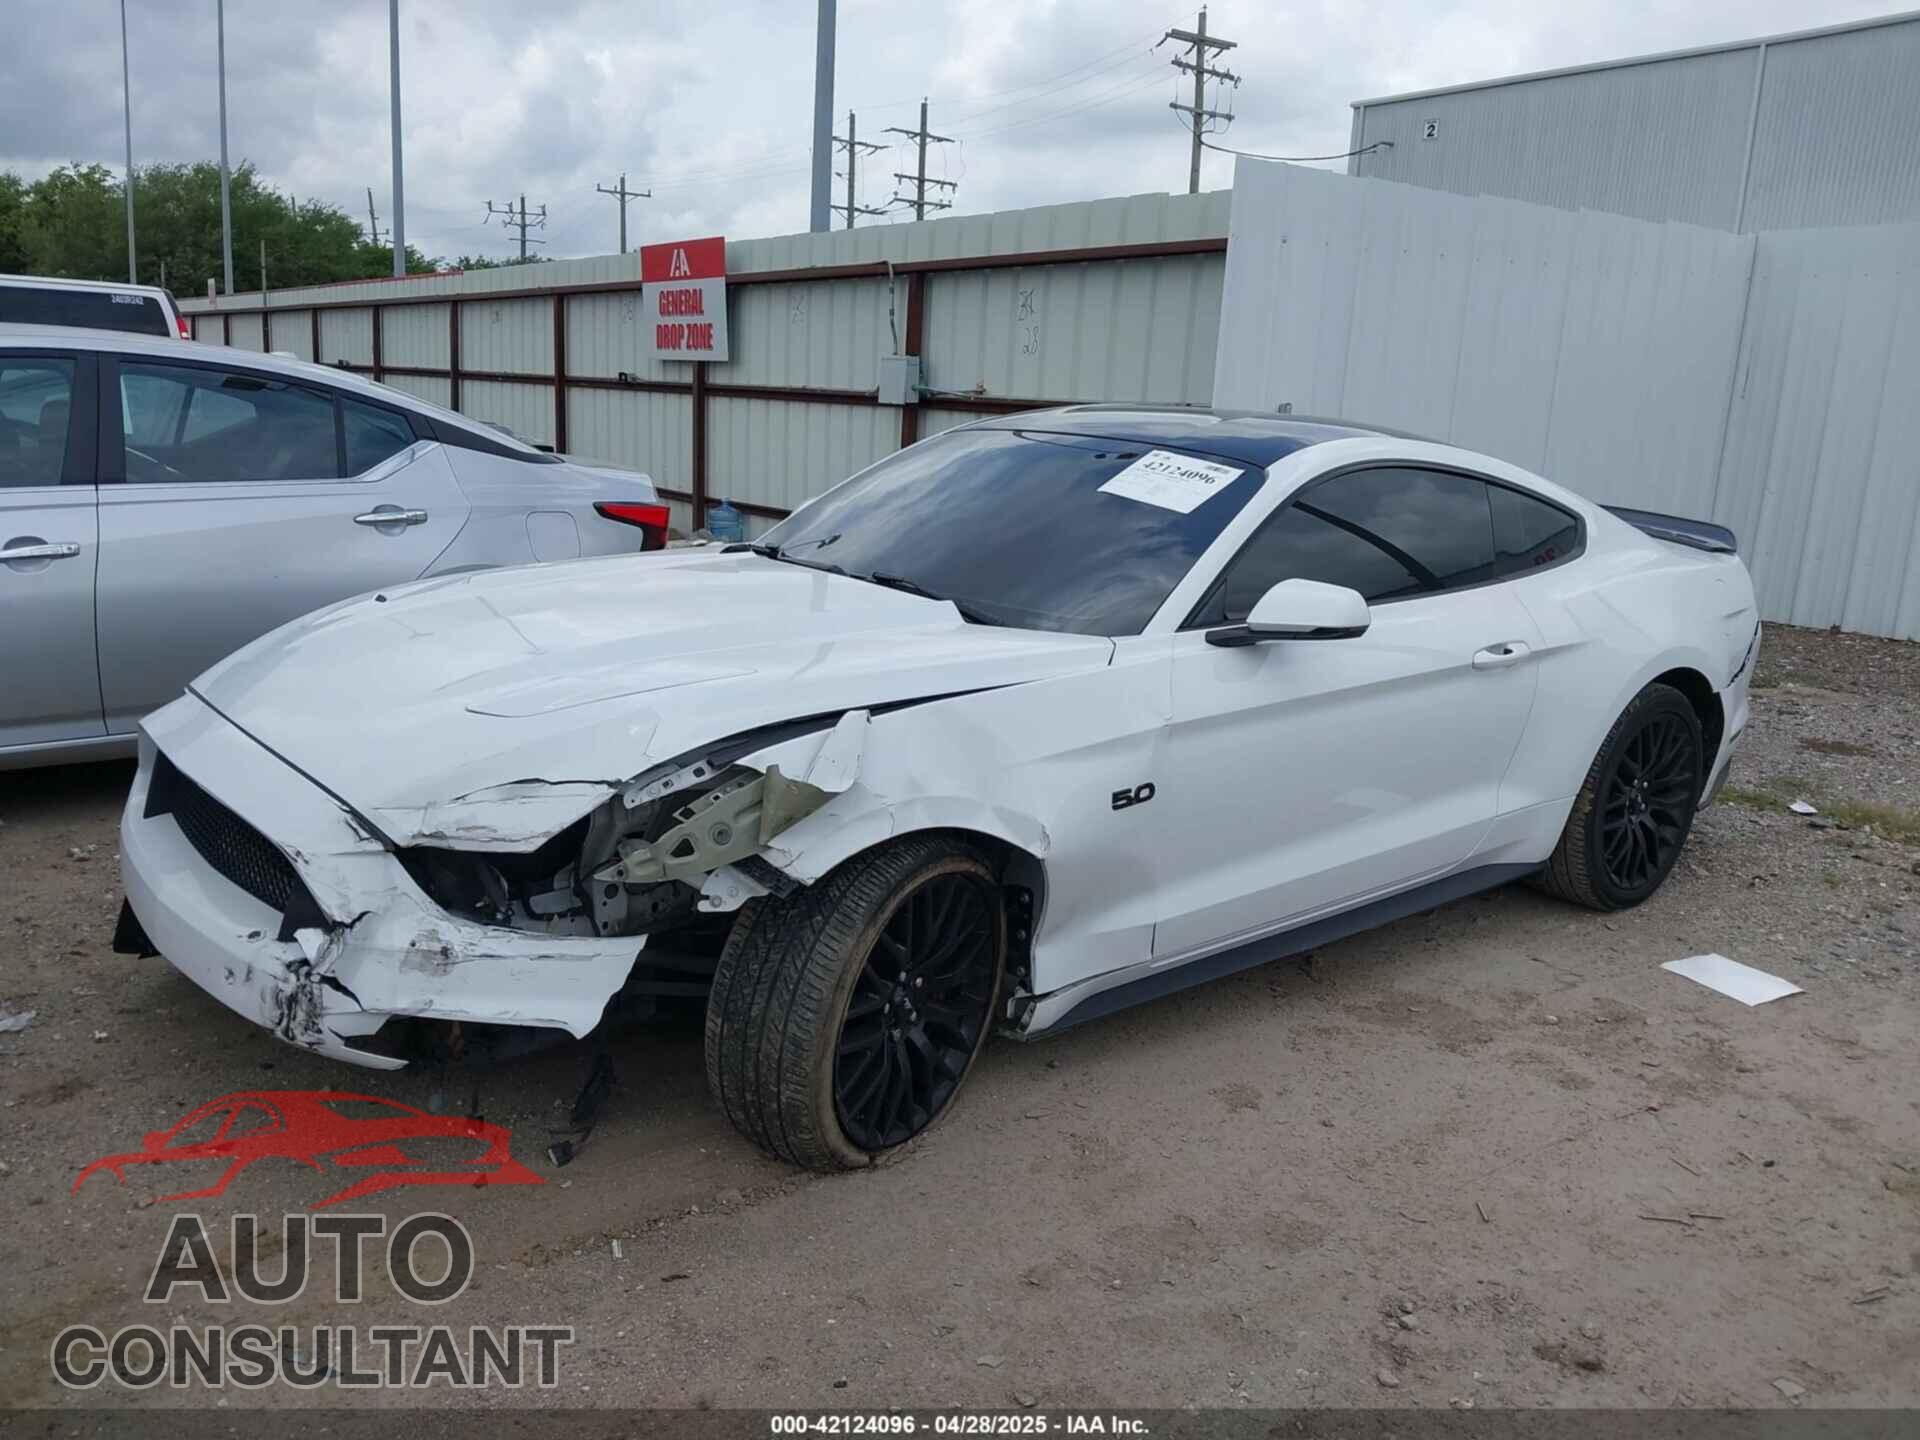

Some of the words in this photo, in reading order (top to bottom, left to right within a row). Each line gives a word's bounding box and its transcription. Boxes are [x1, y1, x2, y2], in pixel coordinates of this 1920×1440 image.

[1426, 124, 1436, 137] 2
[658, 287, 704, 317] GENERAL
[656, 323, 684, 350] DROP
[686, 322, 714, 351] ZONE
[1111, 782, 1156, 811] 5.0
